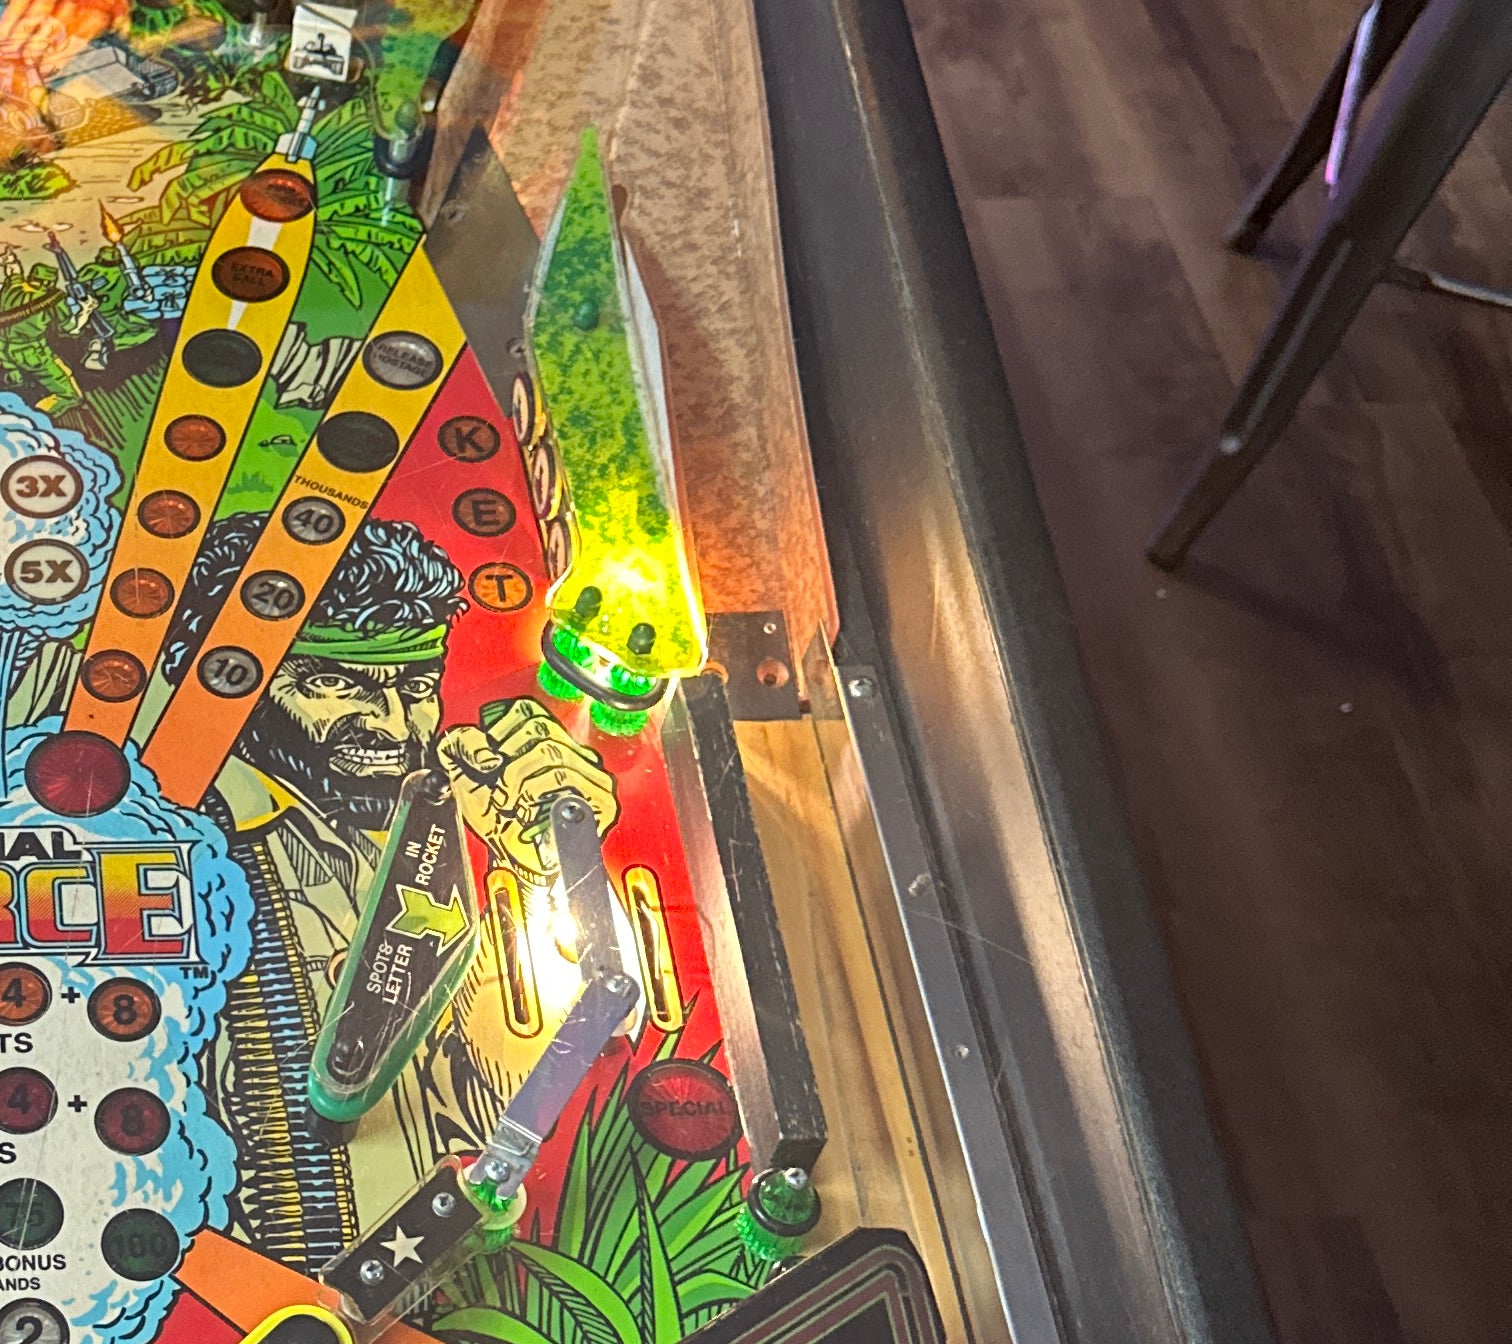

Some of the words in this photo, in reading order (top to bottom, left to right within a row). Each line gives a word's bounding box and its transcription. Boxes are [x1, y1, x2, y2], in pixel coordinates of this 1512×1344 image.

[453, 428, 484, 452] K
[16, 475, 67, 499] 3X
[294, 474, 369, 510] THOUSANDS
[297, 510, 334, 532] 40
[472, 500, 497, 525] E
[19, 560, 74, 584] 5X
[251, 584, 292, 609] 20
[484, 574, 515, 602] T
[216, 659, 248, 685] 10
[416, 825, 446, 887] ROCKET
[366, 944, 394, 994] SPOTS
[382, 944, 413, 1005] LETTER
[0, 977, 26, 1008] 4
[112, 993, 136, 1026] 8
